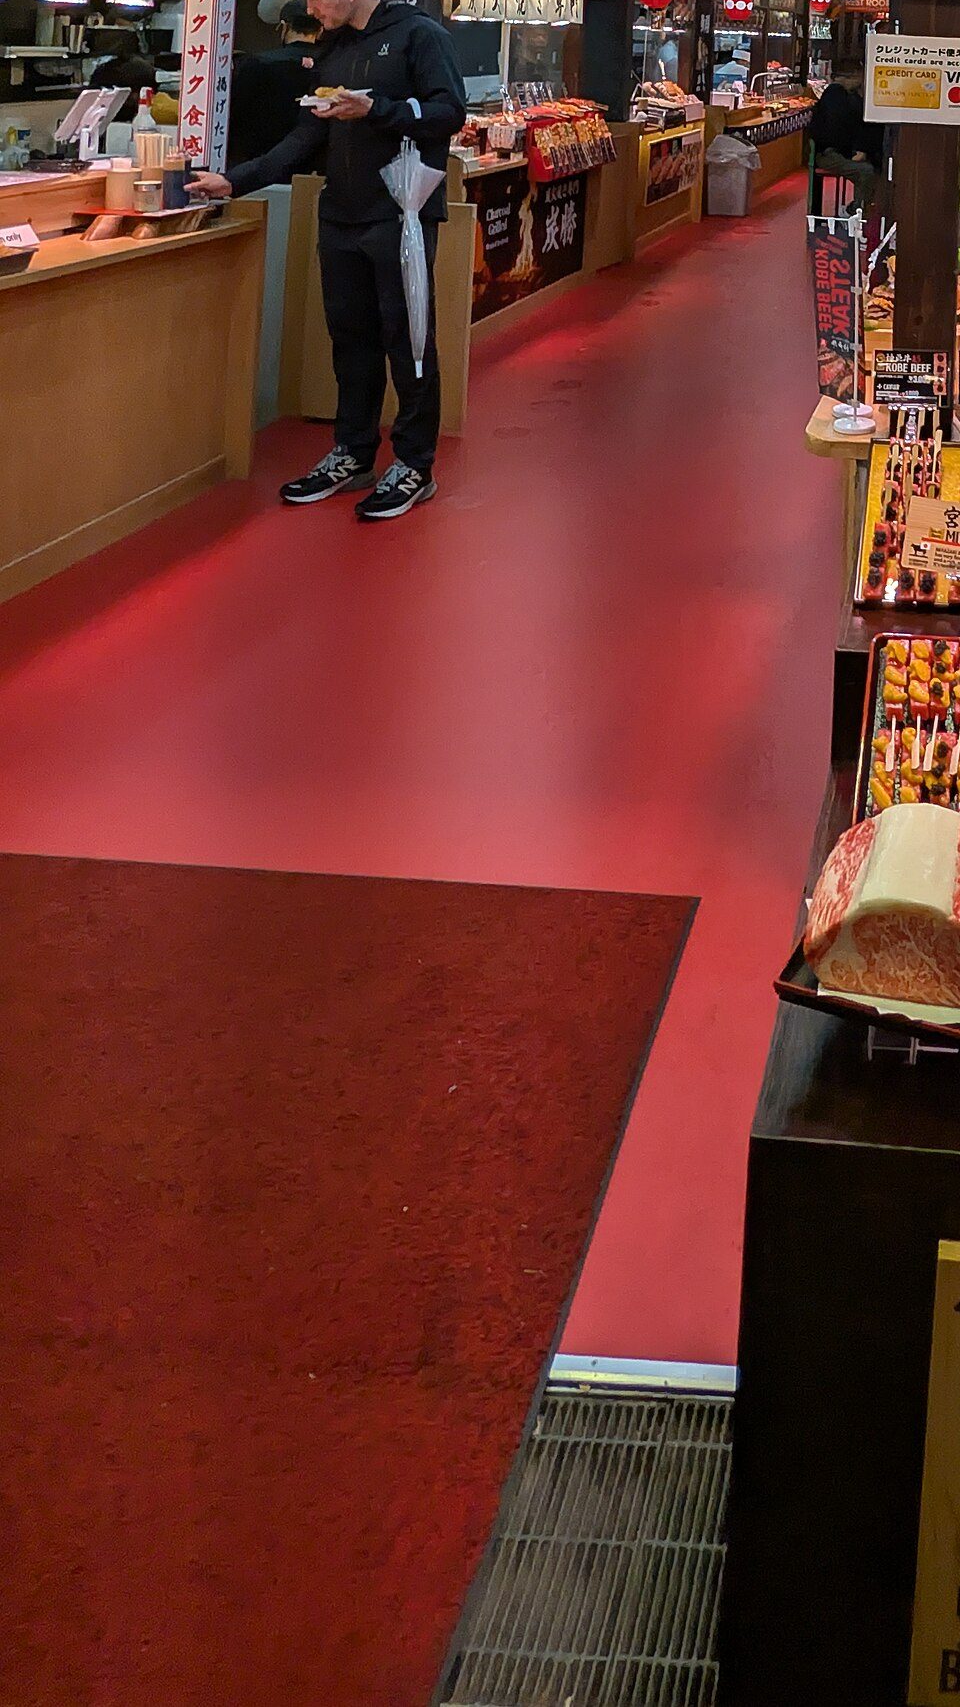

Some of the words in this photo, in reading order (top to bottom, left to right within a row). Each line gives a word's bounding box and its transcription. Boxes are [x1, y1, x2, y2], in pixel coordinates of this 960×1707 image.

[875, 55, 901, 64] Credit
[904, 57, 927, 65] cards
[885, 69, 914, 78] CREDIT
[915, 71, 937, 79] CARD
[885, 363, 908, 373] KOBE
